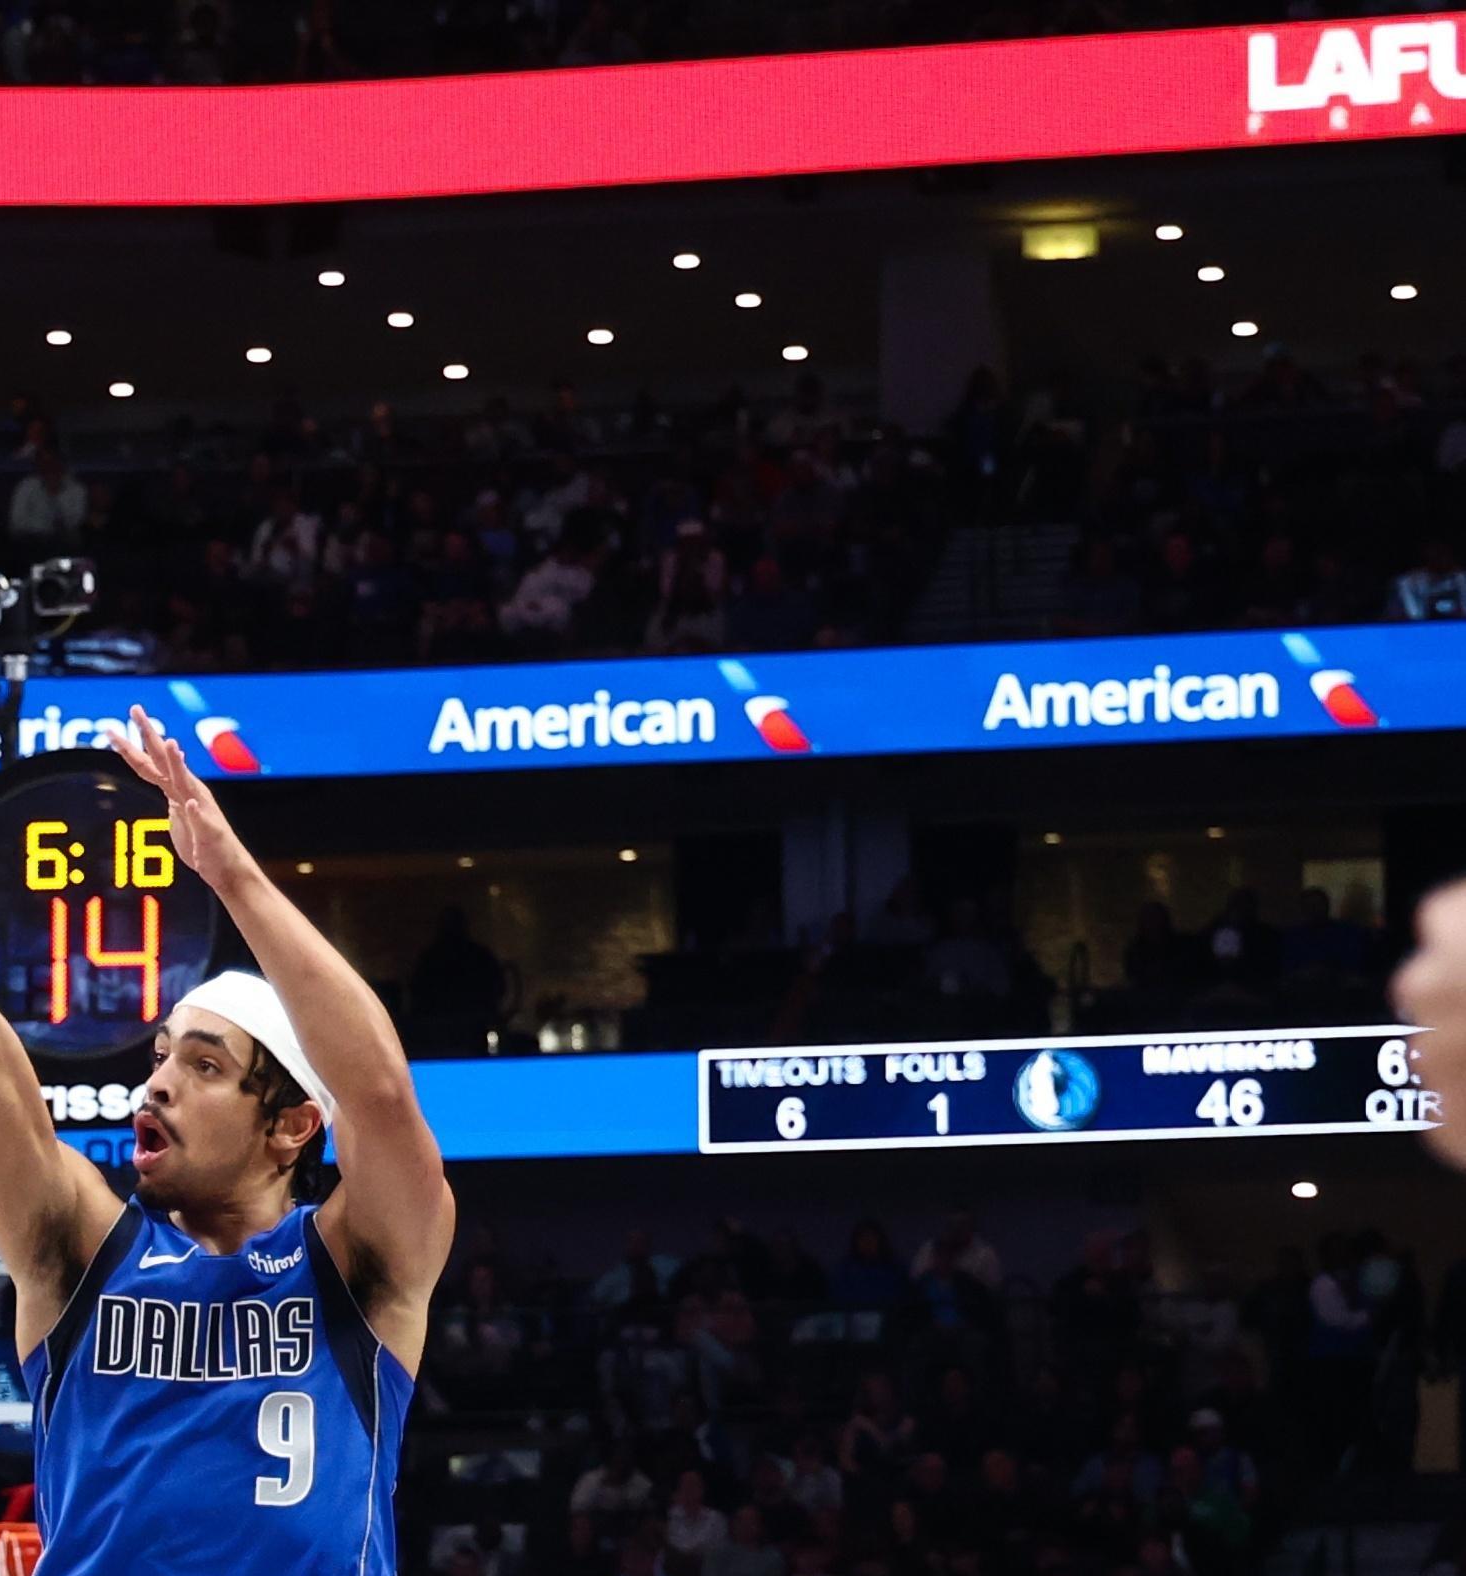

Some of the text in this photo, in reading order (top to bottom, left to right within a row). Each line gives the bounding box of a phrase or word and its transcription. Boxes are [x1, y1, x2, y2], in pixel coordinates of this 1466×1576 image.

[429, 690, 715, 753] American
[983, 665, 1279, 730] American
[26, 818, 174, 890] 6:16
[50, 895, 160, 1024] 14
[716, 1050, 987, 1088] TIMEOUTS FOULS
[1142, 1041, 1316, 1075] MAVERICKS
[775, 1092, 949, 1140] 6 1
[1195, 1078, 1265, 1128] 46
[248, 1246, 303, 1274] chime
[93, 1294, 314, 1381] DALLAS
[254, 1391, 315, 1506] 9
